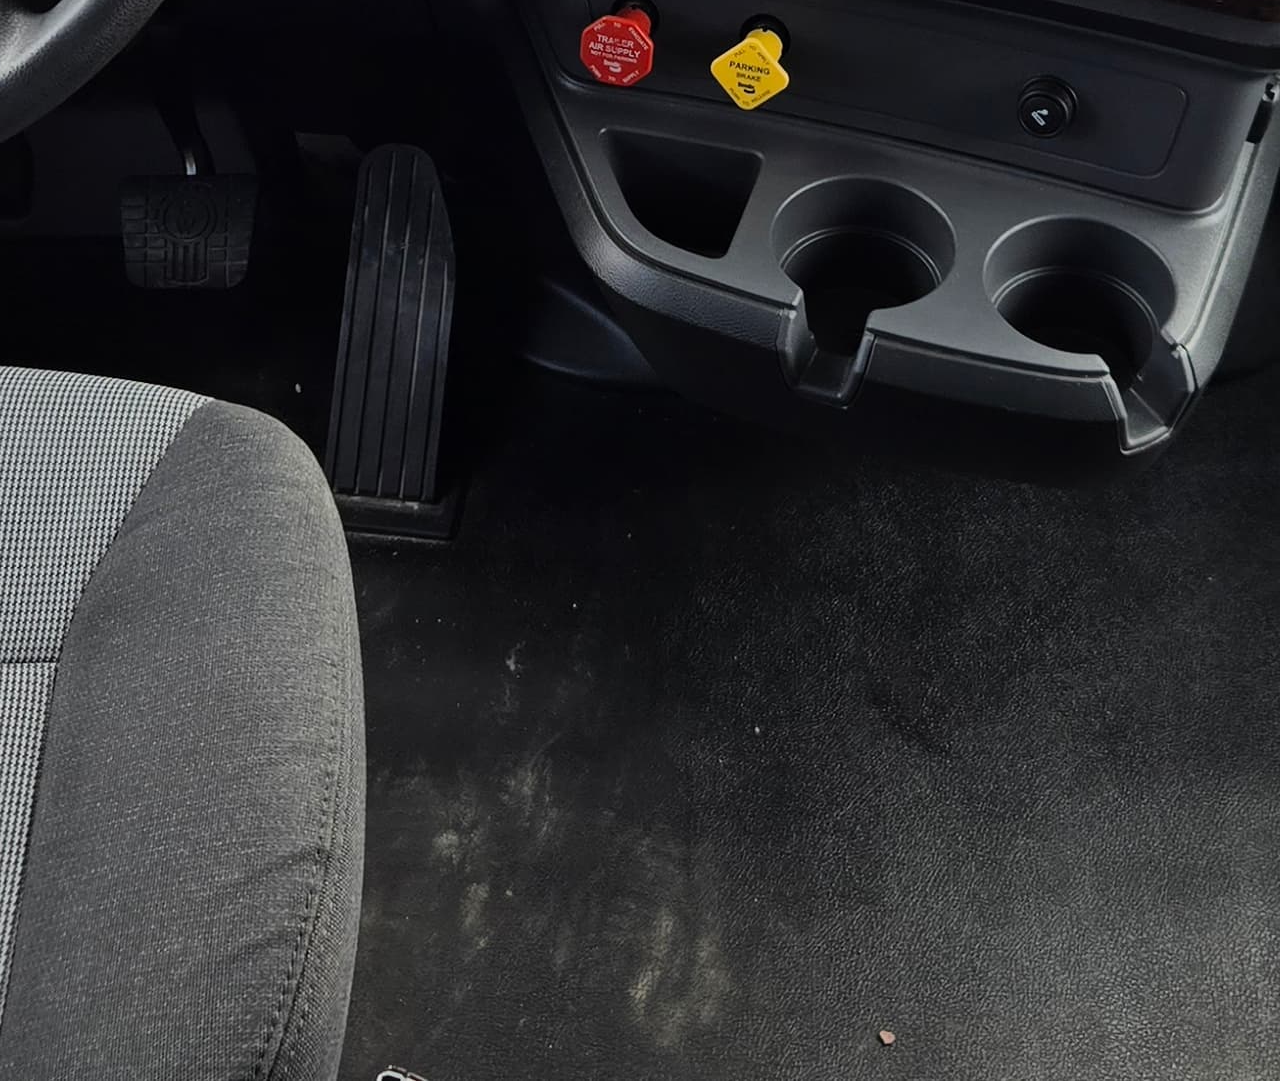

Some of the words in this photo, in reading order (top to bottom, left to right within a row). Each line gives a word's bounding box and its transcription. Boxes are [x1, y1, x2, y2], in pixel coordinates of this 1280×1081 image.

[597, 34, 634, 48] TRAILER
[589, 41, 604, 51] AIR
[605, 45, 641, 58] SUPPLY
[729, 60, 770, 75] PARKING
[736, 72, 761, 82] BRAKE
